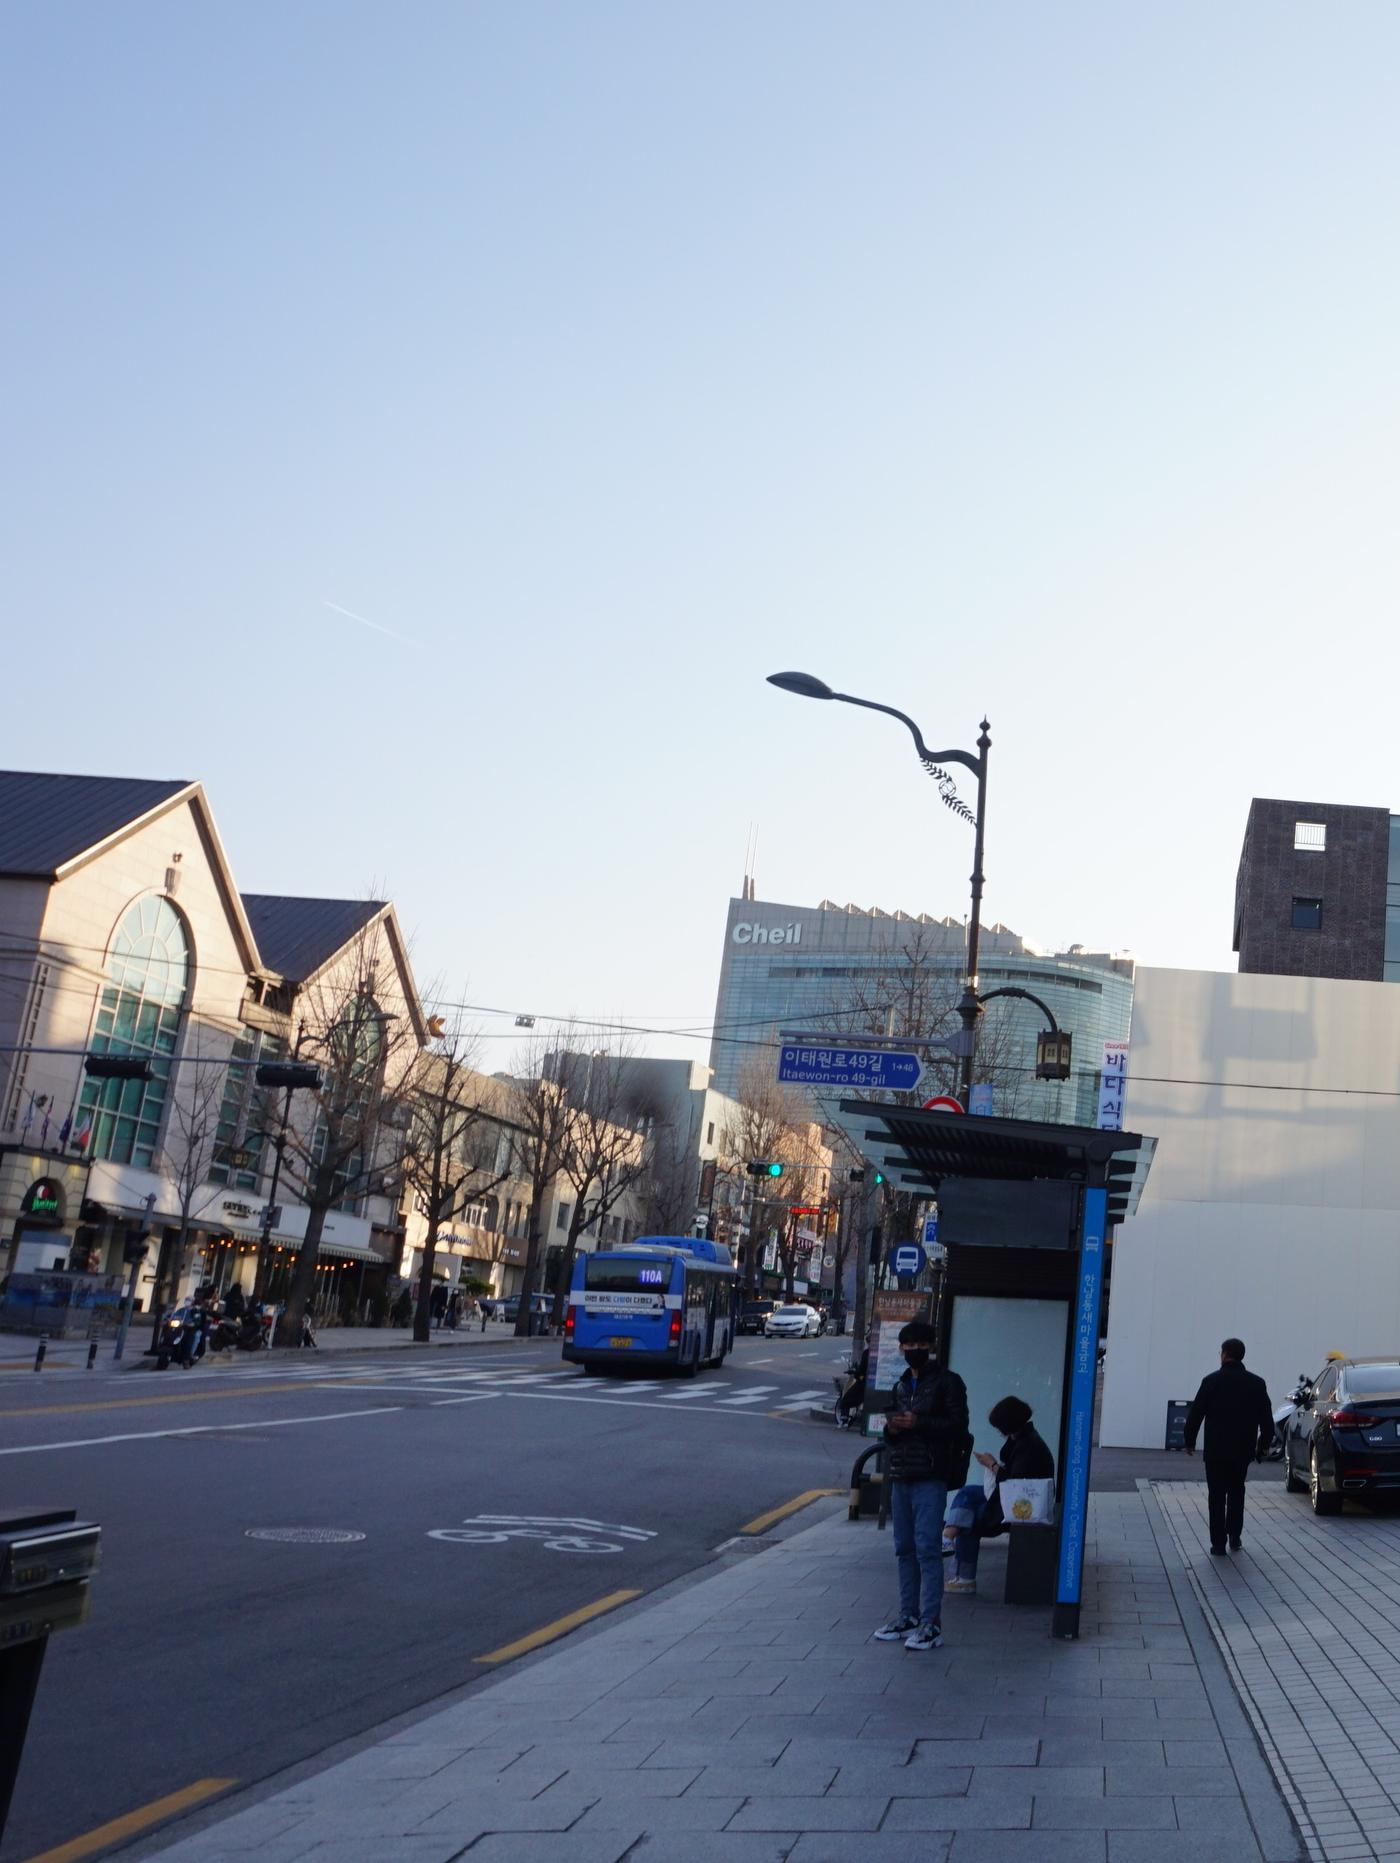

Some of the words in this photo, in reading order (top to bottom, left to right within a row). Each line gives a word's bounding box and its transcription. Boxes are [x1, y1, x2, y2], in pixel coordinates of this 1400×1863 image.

[732, 922, 802, 945] Cheil
[785, 1050, 883, 1072] 이태원로49길
[782, 1068, 849, 1082] Itaewon-ro
[851, 1072, 886, 1086] 49-gil
[641, 1271, 662, 1284] 110A
